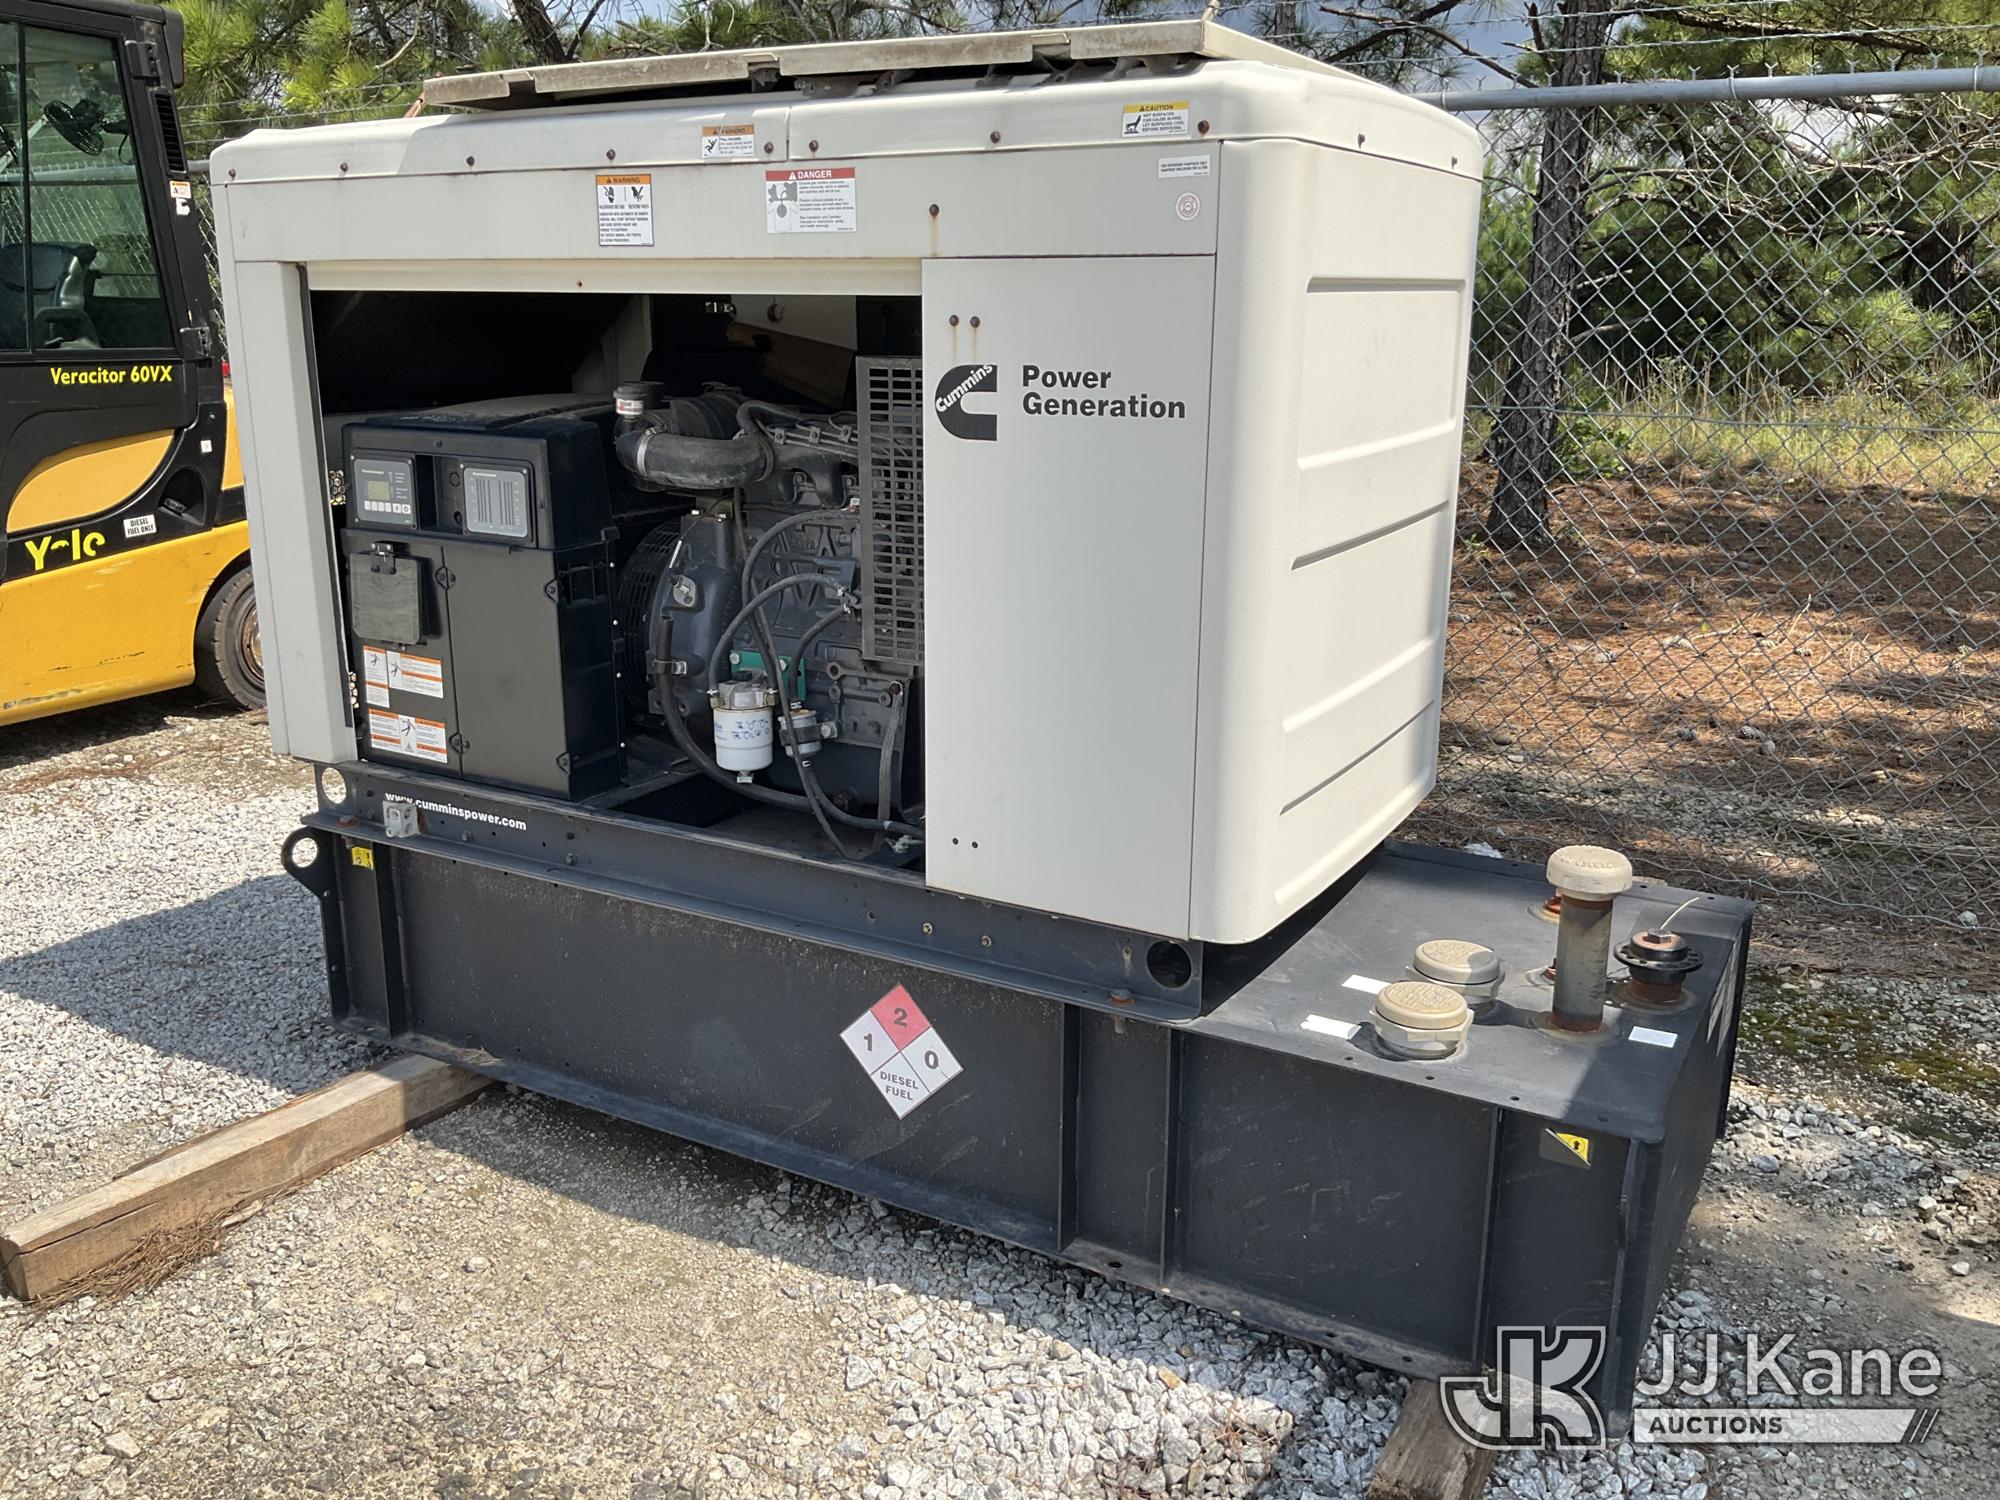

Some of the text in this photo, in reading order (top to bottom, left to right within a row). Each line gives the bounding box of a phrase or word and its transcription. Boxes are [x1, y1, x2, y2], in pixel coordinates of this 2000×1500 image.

[1145, 104, 1174, 112] CAUTION
[797, 170, 832, 180] DANGER
[50, 365, 173, 385] Veracitor 60VX
[1022, 364, 1112, 389] Power
[935, 363, 993, 413] Cummins
[1022, 391, 1186, 419] Generation
[127, 524, 154, 535] FUEL ONLY
[130, 517, 149, 527] DIESEL
[385, 792, 527, 831] www.cumminspower.com
[894, 1007, 908, 1028] 2
[863, 1032, 873, 1052] 1
[924, 1050, 939, 1069] 0
[880, 1070, 919, 1090] DIESEL
[885, 1085, 914, 1101] FUEL
